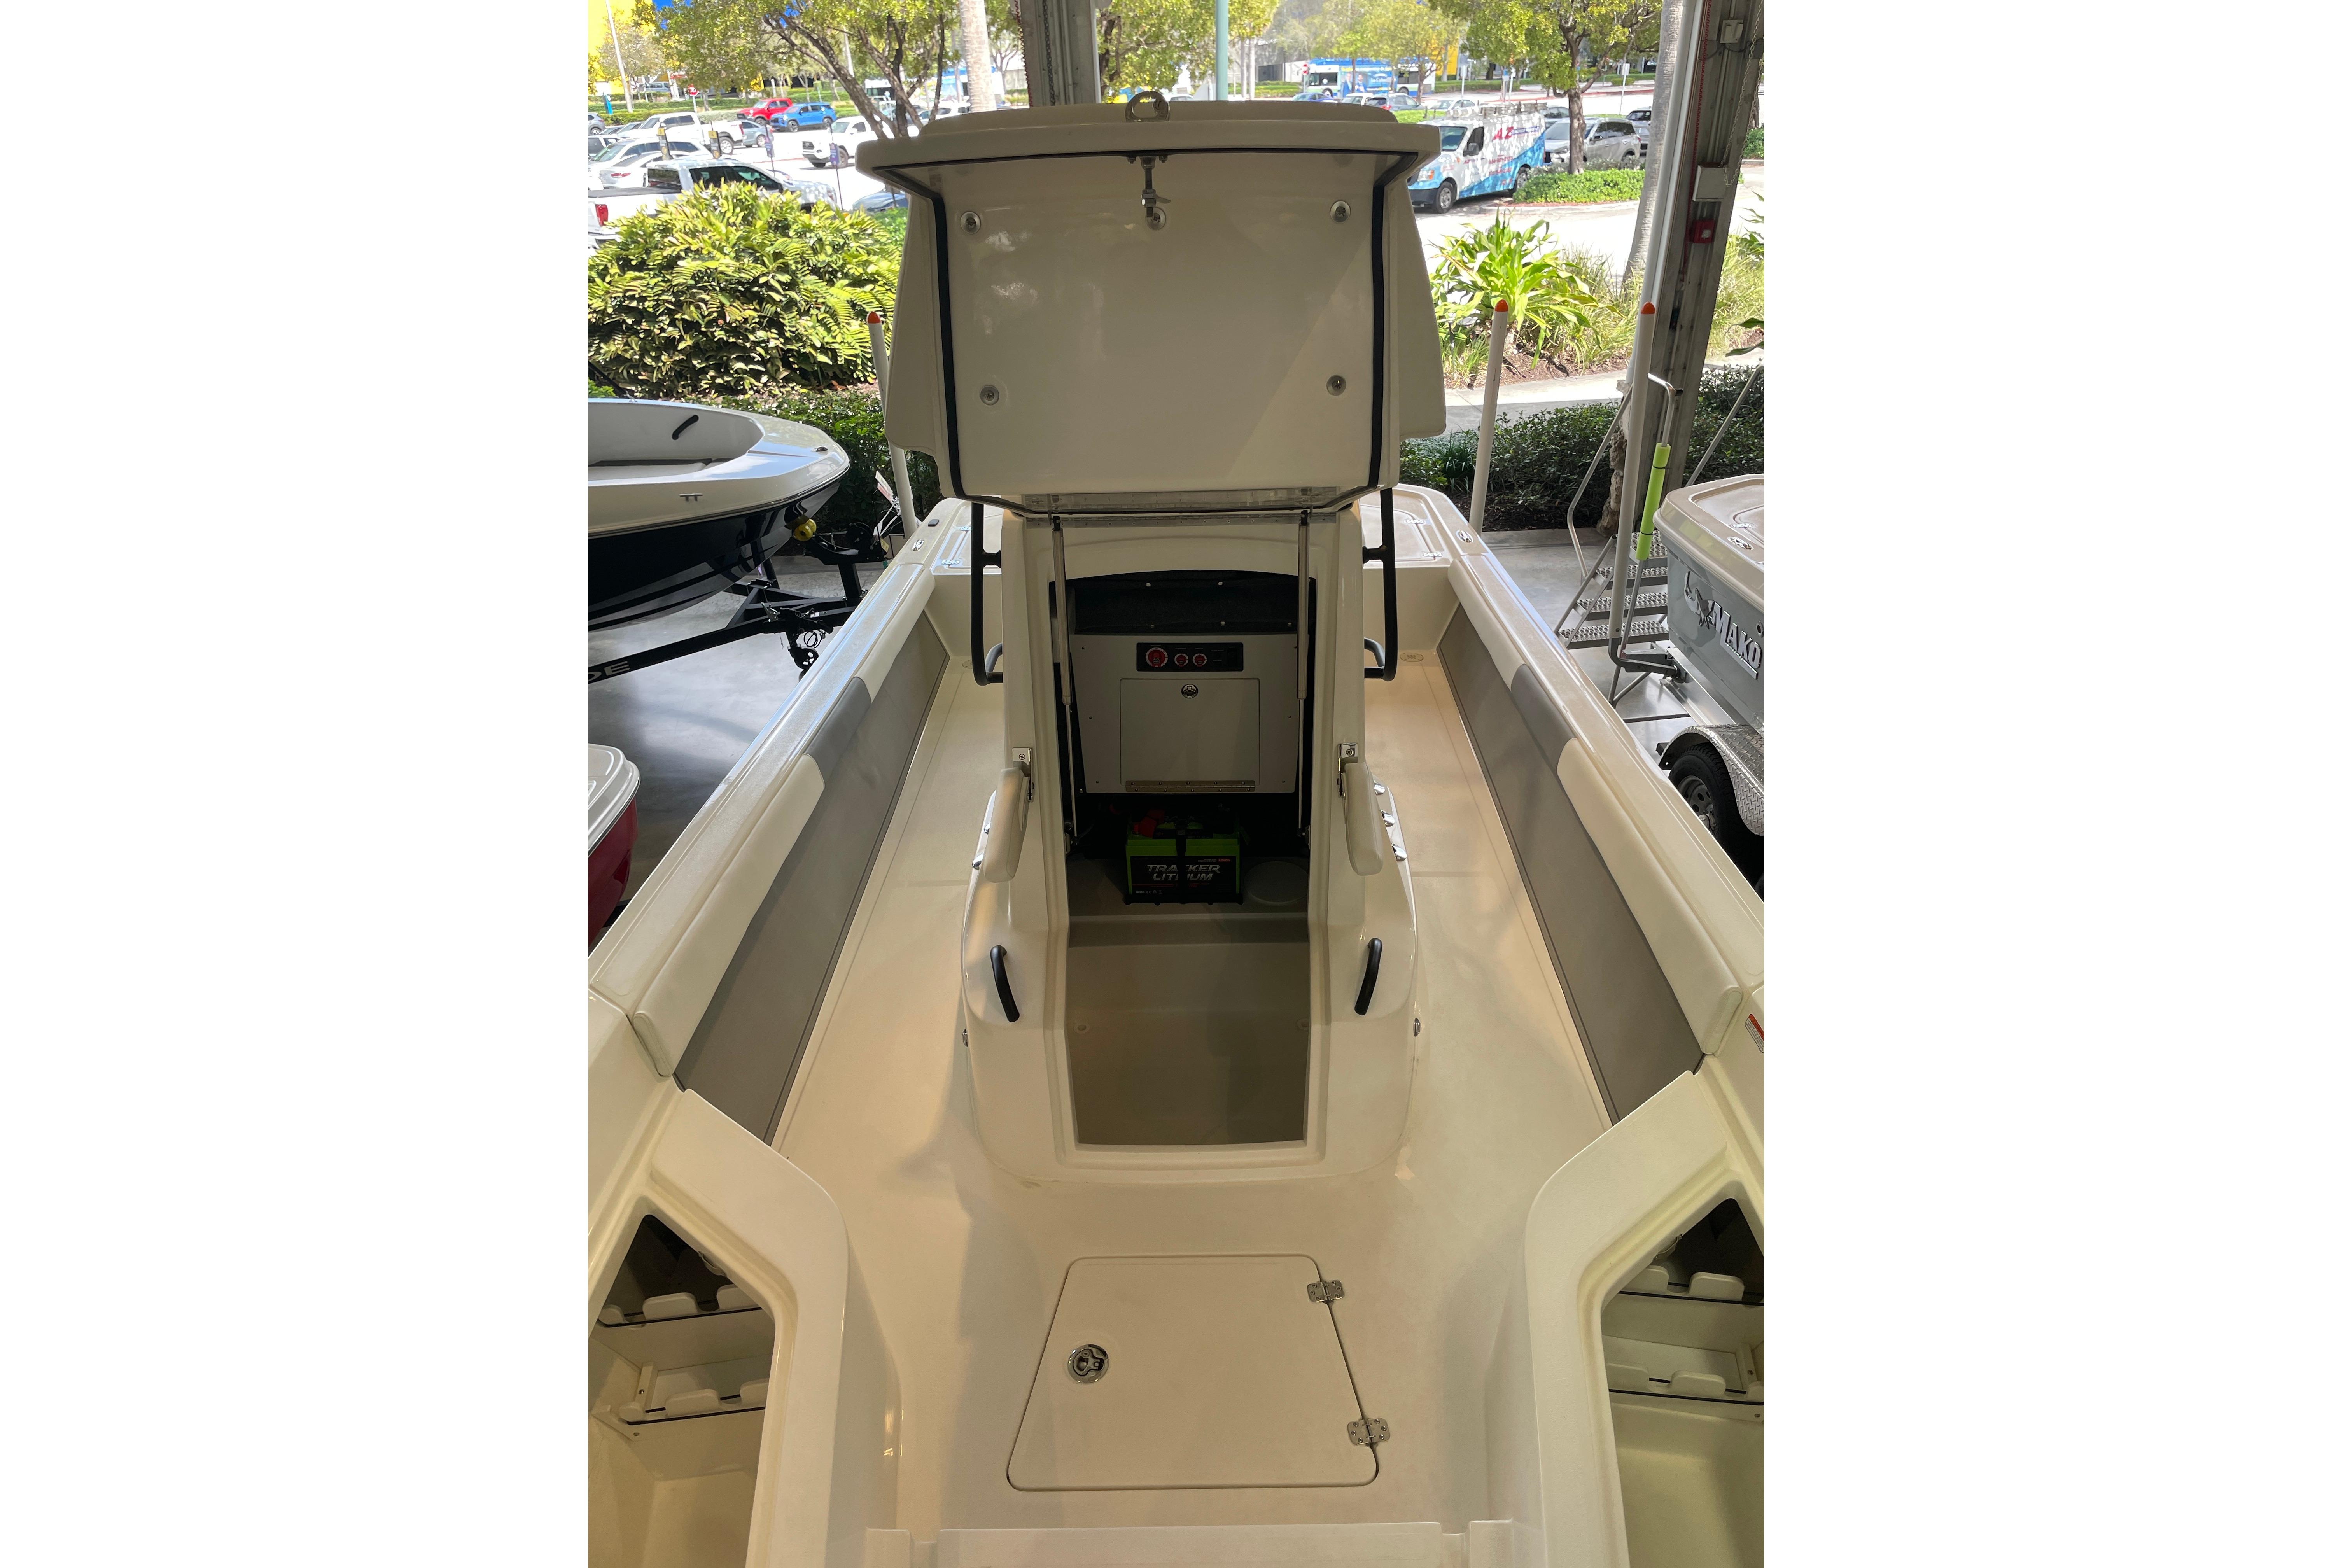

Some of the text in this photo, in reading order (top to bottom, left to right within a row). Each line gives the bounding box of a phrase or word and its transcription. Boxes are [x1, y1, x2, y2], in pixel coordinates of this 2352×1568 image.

[1492, 126, 1514, 141] AZ
[1712, 602, 1762, 679] MAKO
[1146, 864, 1221, 874] TRAKER
